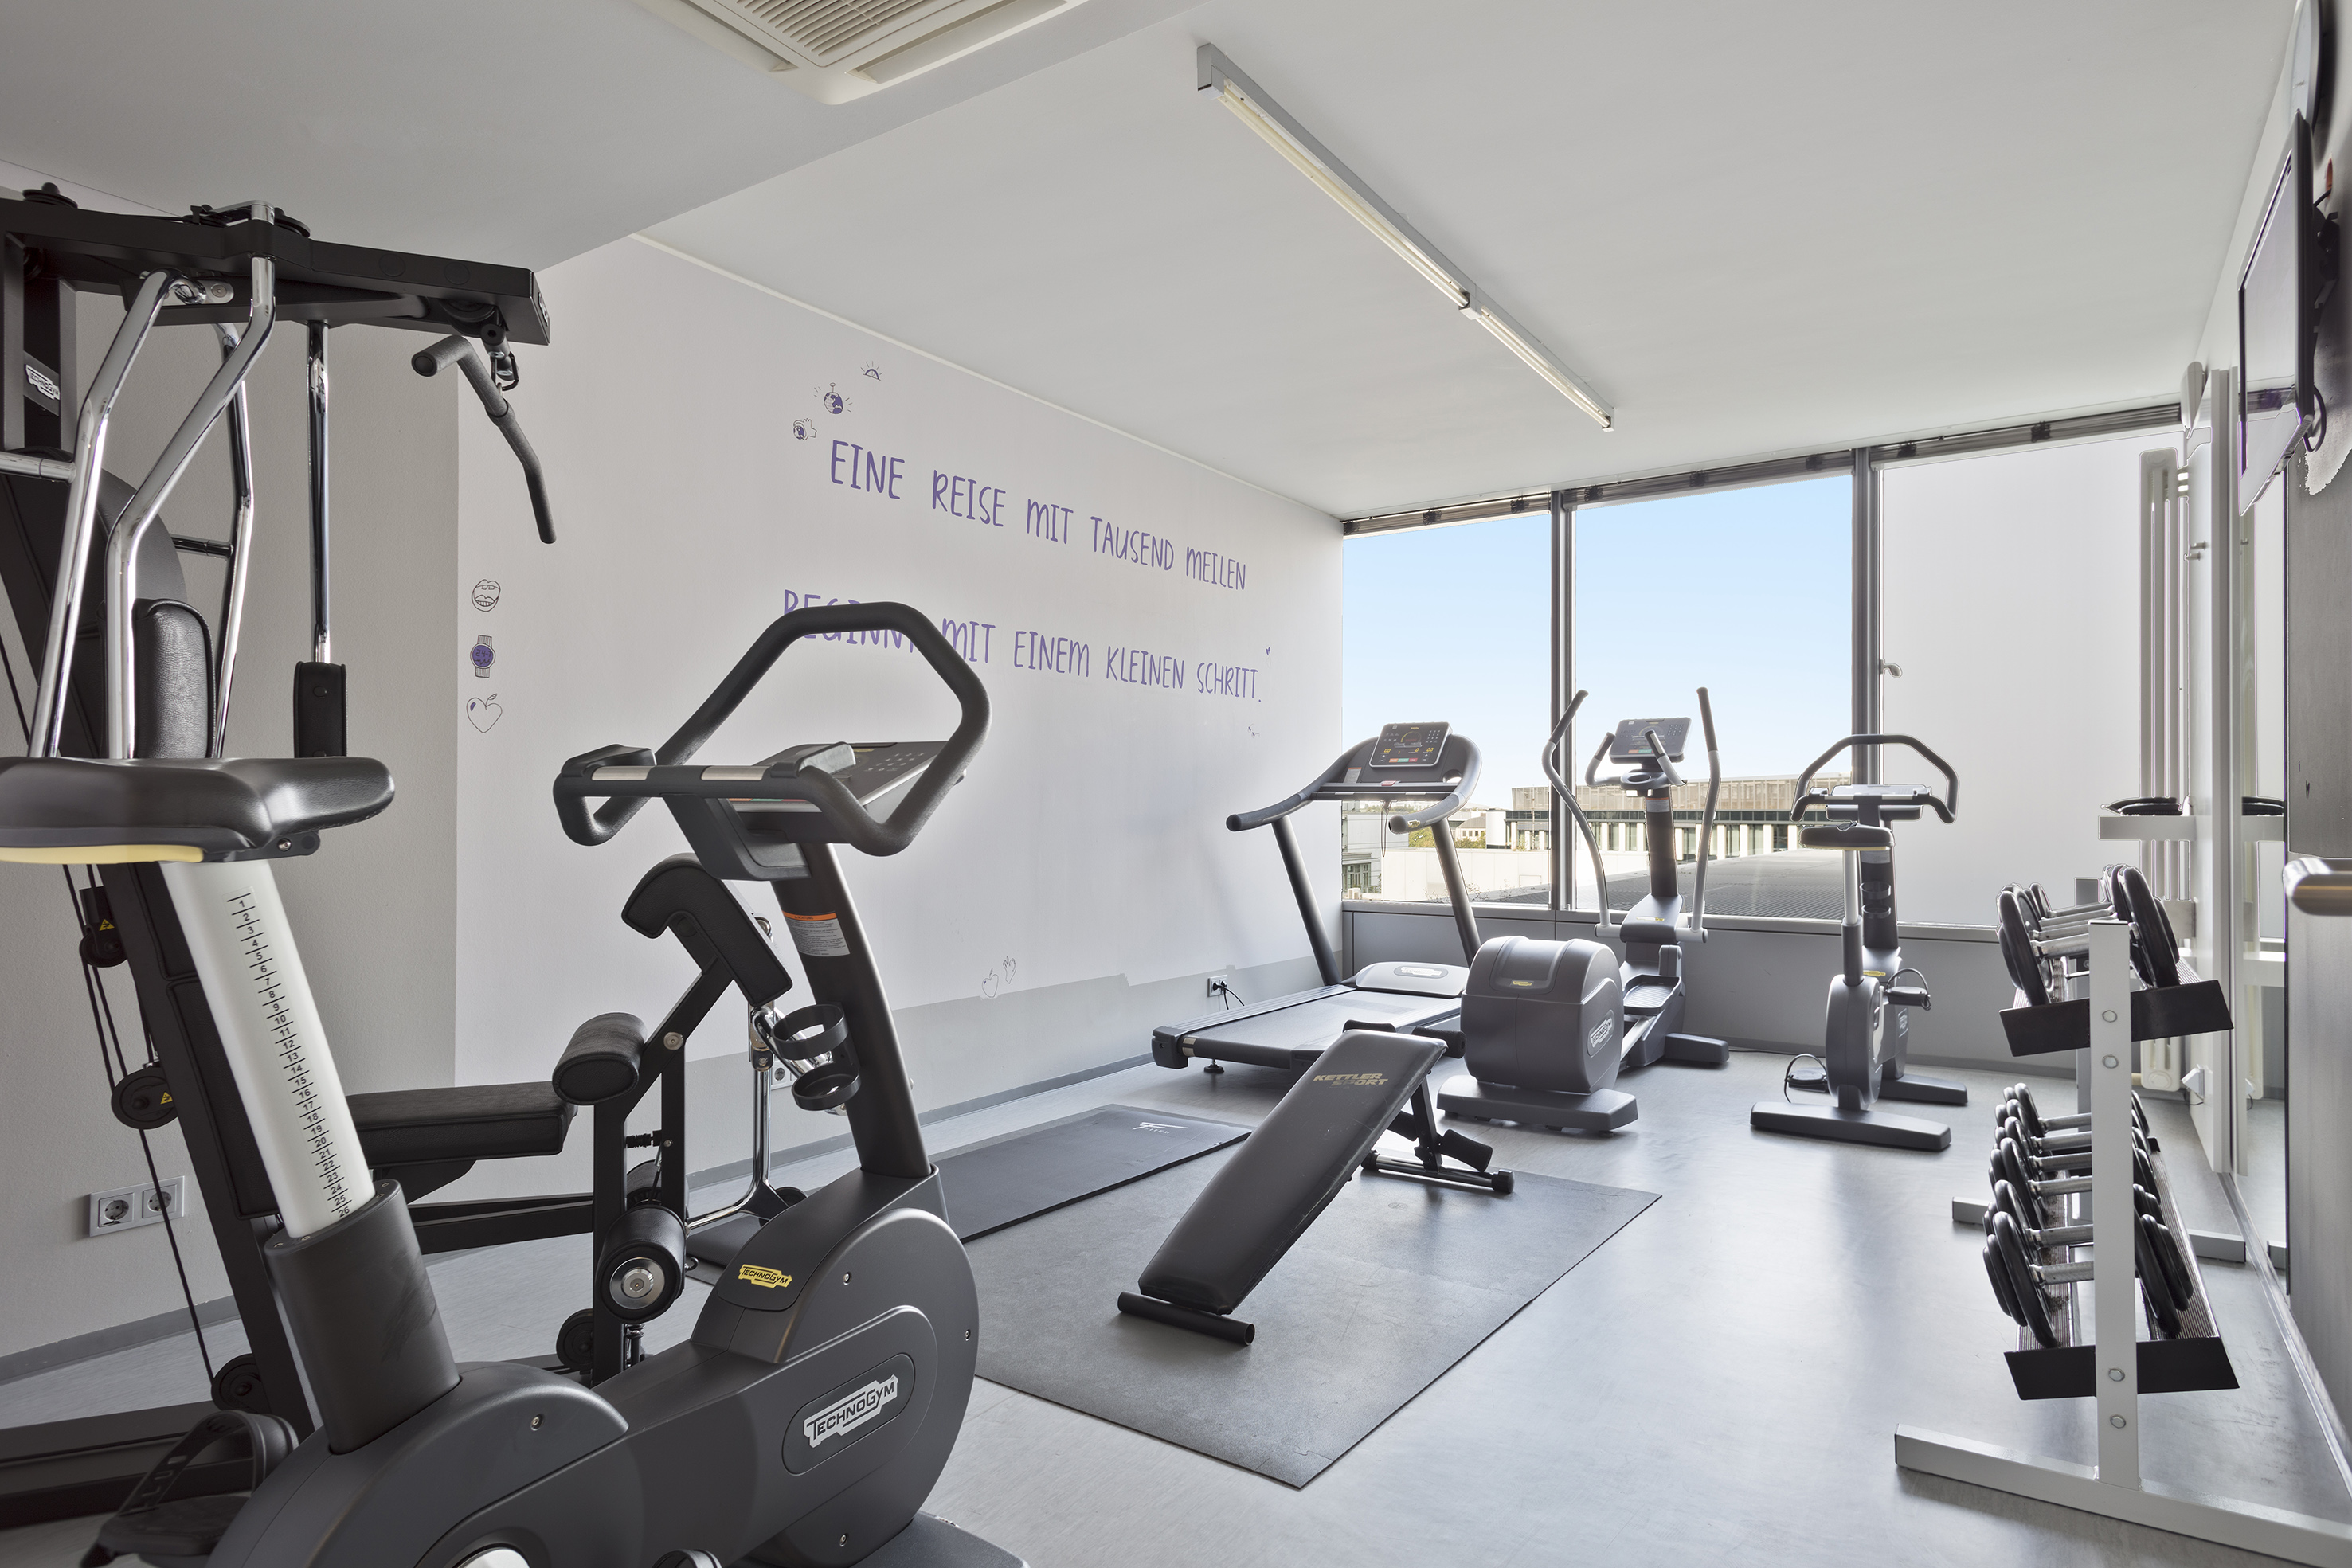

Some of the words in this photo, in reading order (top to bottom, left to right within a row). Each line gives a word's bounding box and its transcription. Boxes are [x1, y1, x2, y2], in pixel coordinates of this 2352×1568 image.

[830, 438, 906, 499] EINE
[931, 468, 1007, 528] REISE
[1025, 498, 1074, 545] MIT
[1090, 515, 1175, 572] TAUSEND
[1185, 545, 1246, 591] MEILEN
[941, 617, 996, 664] MIT
[1012, 630, 1090, 678] EINEM
[1106, 645, 1185, 690] KLEINEN
[1196, 661, 1262, 703] SCHRITT.
[242, 913, 250, 922] 2
[247, 926, 255, 935] 3
[256, 952, 263, 960] 5
[260, 964, 268, 973] 6
[264, 977, 270, 986] 7
[268, 990, 276, 999] 8
[272, 1003, 280, 1011] 9
[274, 1015, 287, 1025] 10
[279, 1026, 291, 1037] 11
[283, 1039, 295, 1050] 12
[287, 1051, 299, 1062] 13
[291, 1064, 303, 1074] 14
[295, 1076, 307, 1086] 15
[1313, 1073, 1383, 1081] KETTLER
[299, 1088, 311, 1099] 16
[303, 1100, 314, 1111] 17
[307, 1112, 319, 1123] 18
[311, 1124, 323, 1135] 19
[315, 1136, 327, 1148] 20
[319, 1148, 331, 1159] 21
[323, 1159, 335, 1171] 22
[326, 1171, 339, 1183] 23
[330, 1183, 342, 1195] 24
[334, 1194, 346, 1206] 25
[338, 1206, 350, 1218] 26
[741, 1265, 789, 1287] TECHNOGYM
[807, 1381, 895, 1441] TECHNOGYM
